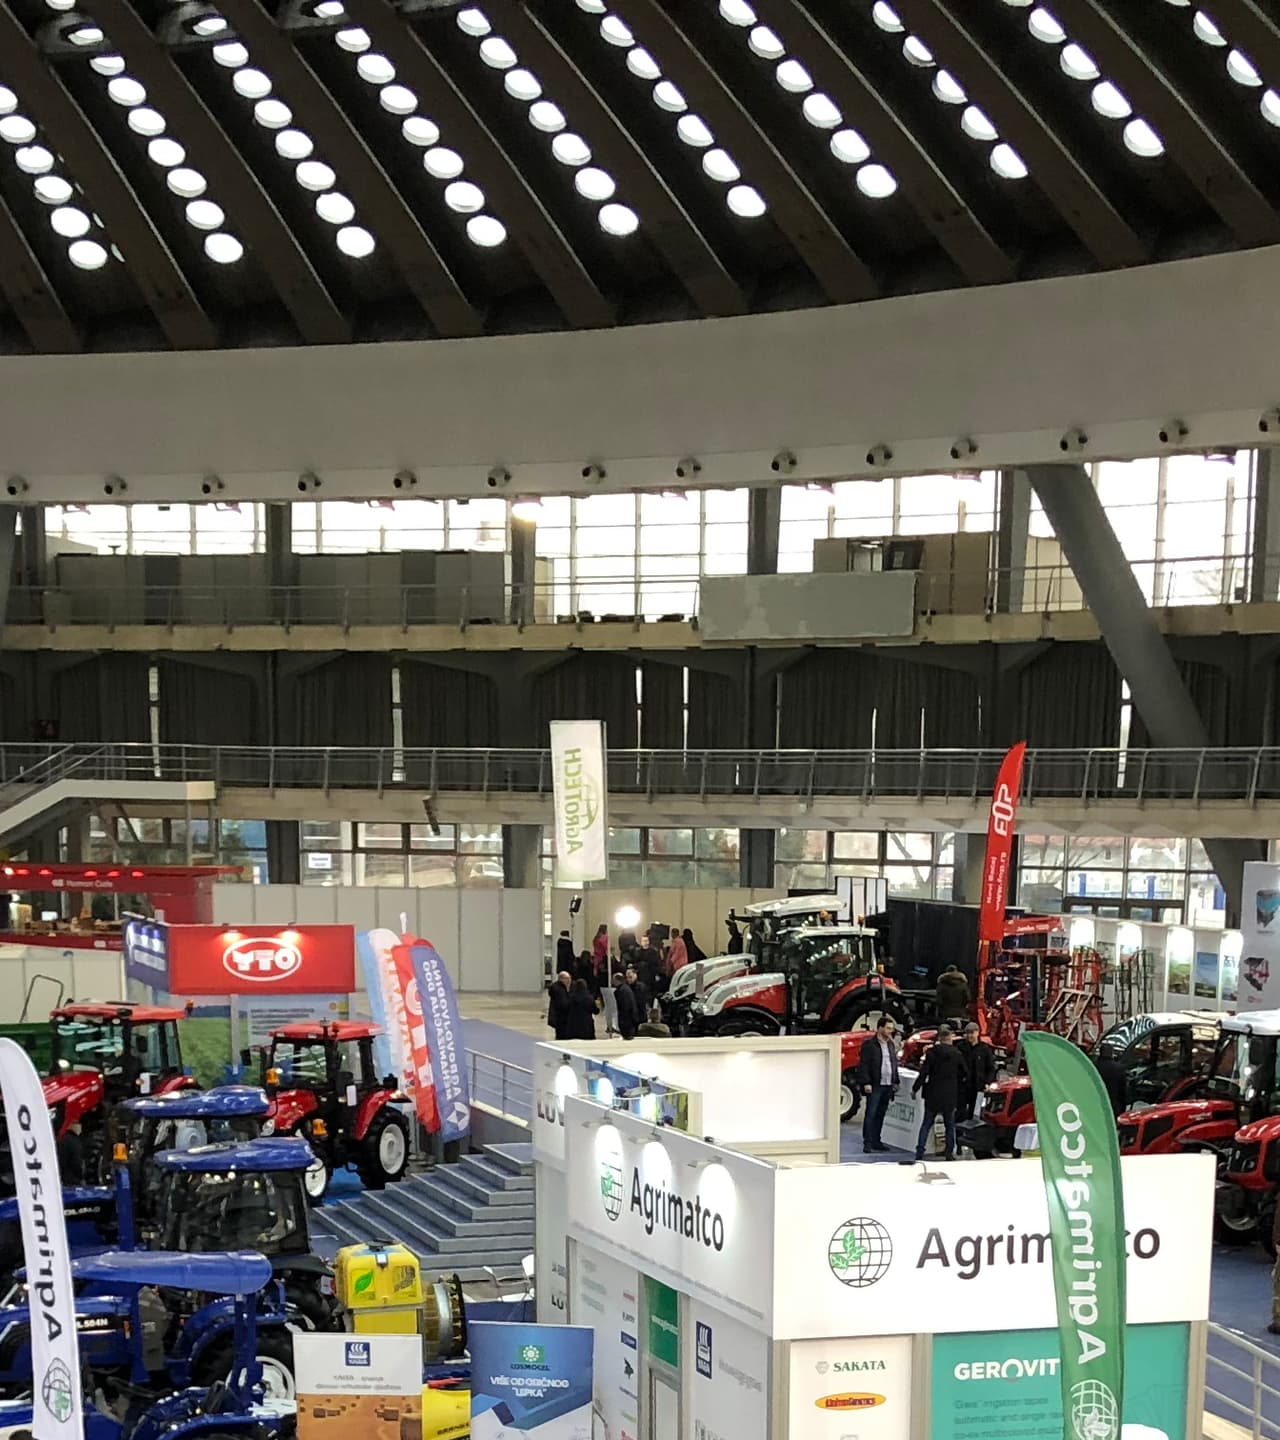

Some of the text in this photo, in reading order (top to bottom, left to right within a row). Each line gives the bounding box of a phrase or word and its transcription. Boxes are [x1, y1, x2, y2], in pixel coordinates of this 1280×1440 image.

[992, 783, 1014, 837] FOP
[231, 948, 297, 971] YTO
[630, 1166, 725, 1252] Agrimatco
[916, 1224, 1161, 1281] Agrimo
[833, 1360, 887, 1373] SAKATA
[953, 1357, 1060, 1383] GEROVIT
